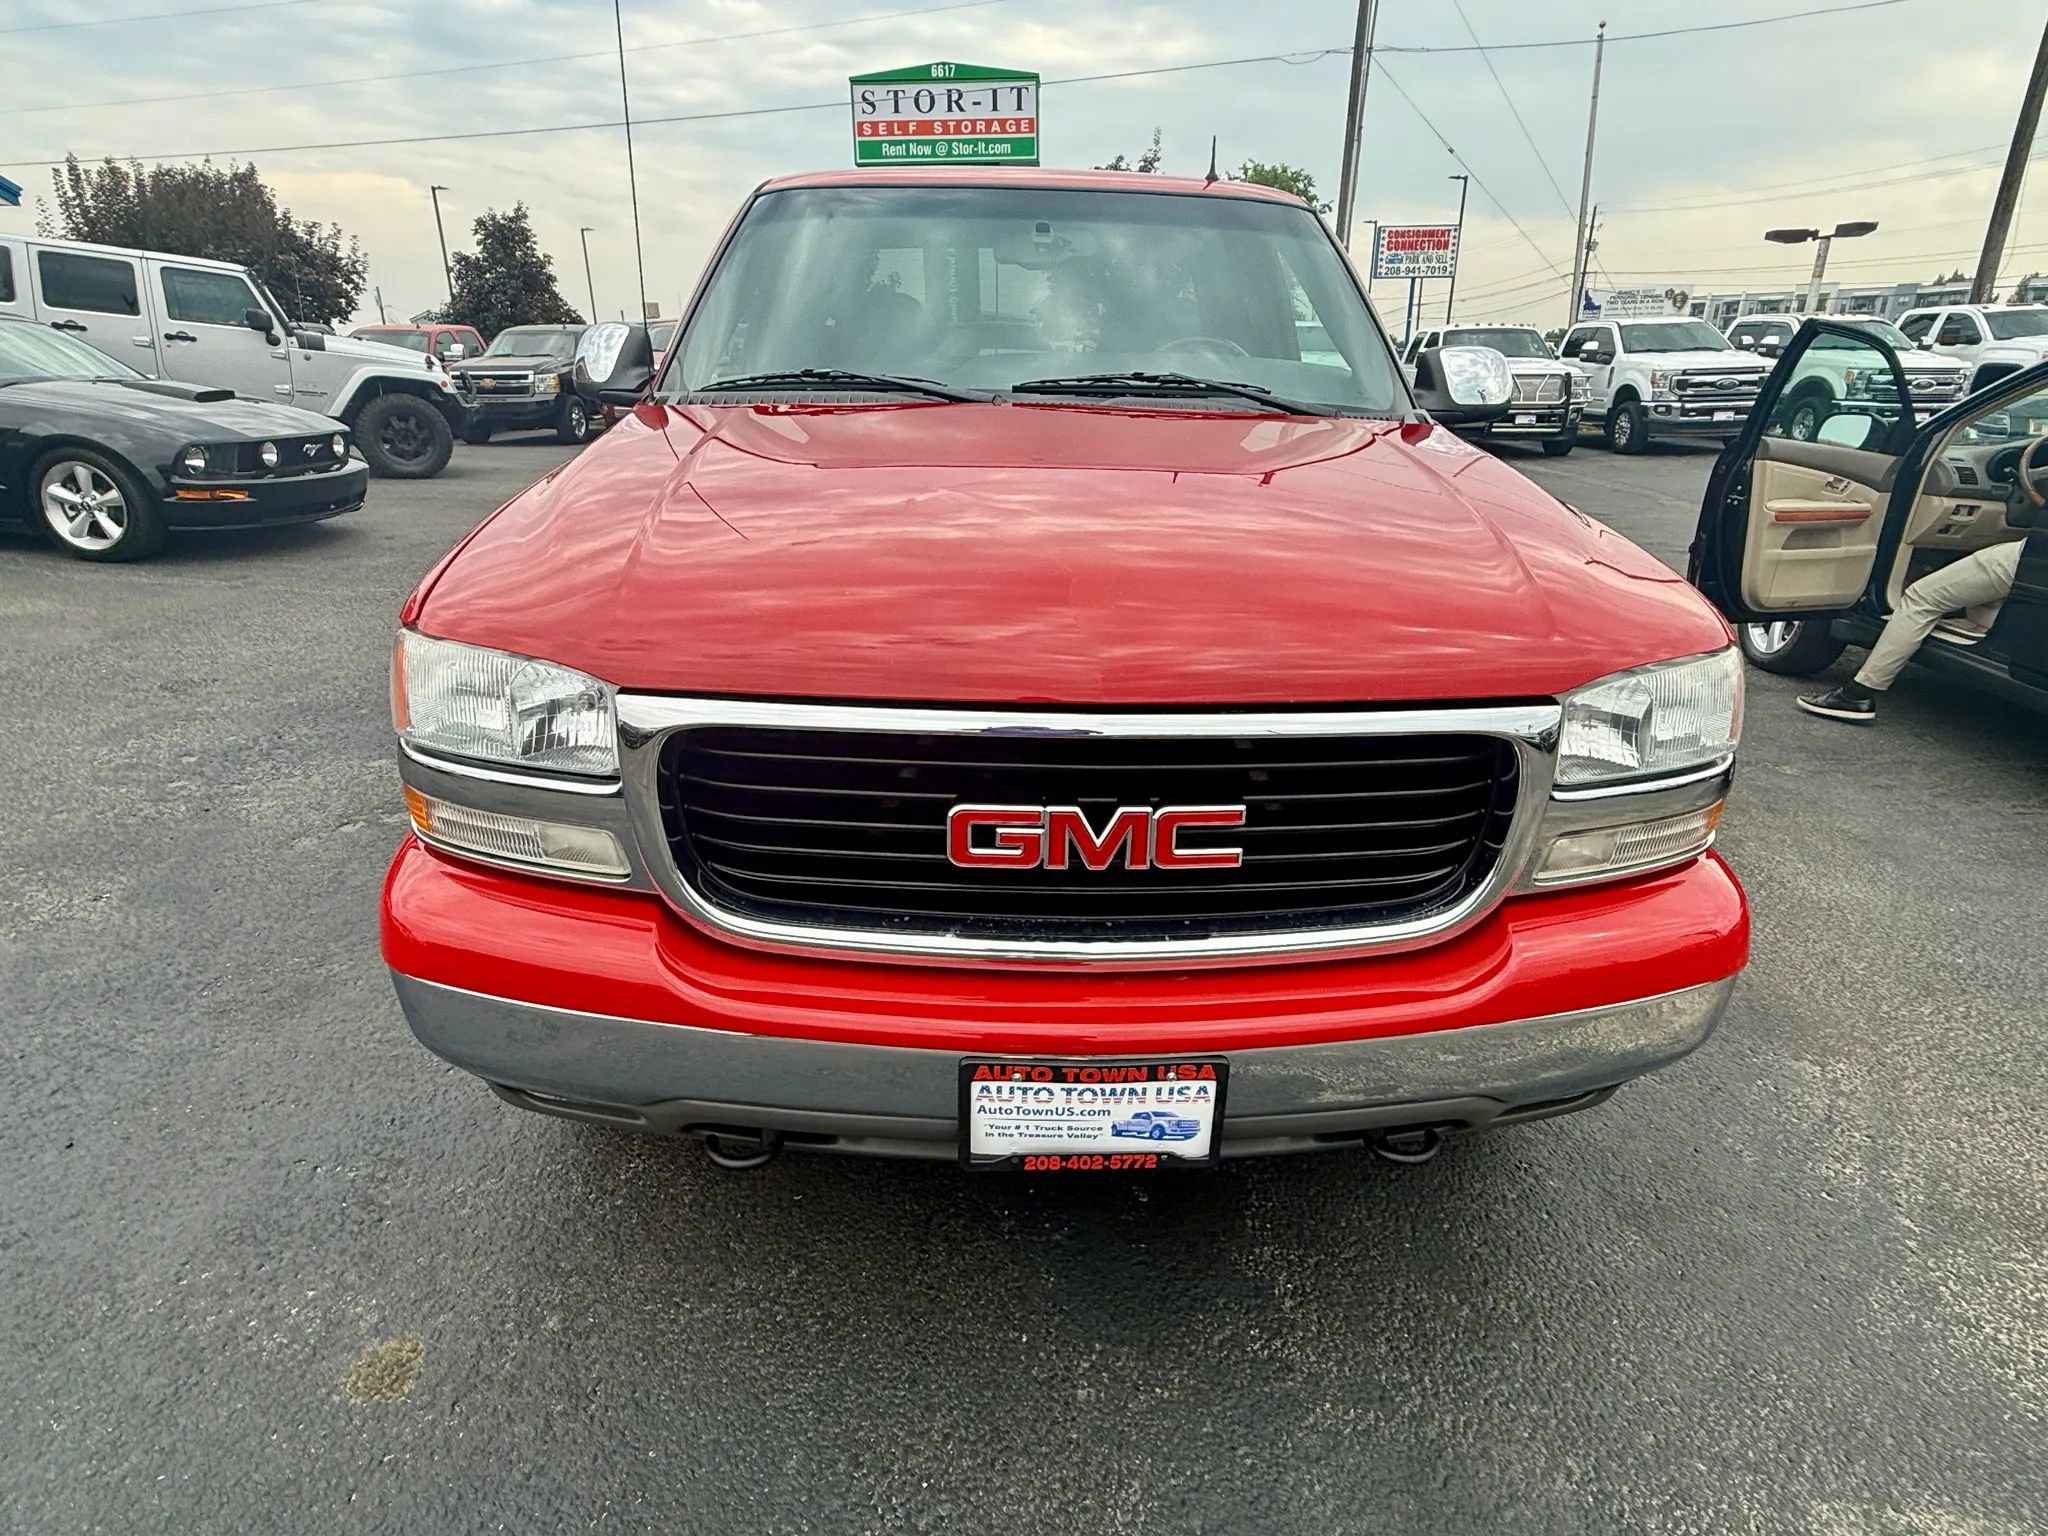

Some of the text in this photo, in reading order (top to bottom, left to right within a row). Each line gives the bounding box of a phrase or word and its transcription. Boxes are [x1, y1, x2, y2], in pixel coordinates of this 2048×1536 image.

[931, 64, 956, 77] 6617
[861, 86, 1029, 115] STOR-IT
[863, 119, 1029, 135] SELF STORAGE
[882, 141, 1011, 156] Rent Now @ Stor-It.com
[1387, 228, 1452, 239] CONSIGNMENT
[1386, 239, 1450, 252] CONNECTION
[1405, 255, 1420, 264] PARK
[1421, 255, 1434, 264] AND
[1435, 254, 1449, 264] SELL
[1384, 265, 1448, 276] 208-941-7019
[947, 804, 1246, 870] GMC
[973, 1065, 1217, 1083] AUTO TOWN USA
[974, 1085, 1212, 1105] AUTO TOWN USA
[977, 1104, 1112, 1117] AutoTownUS.com
[1023, 1154, 1157, 1170] 208-402-5772
